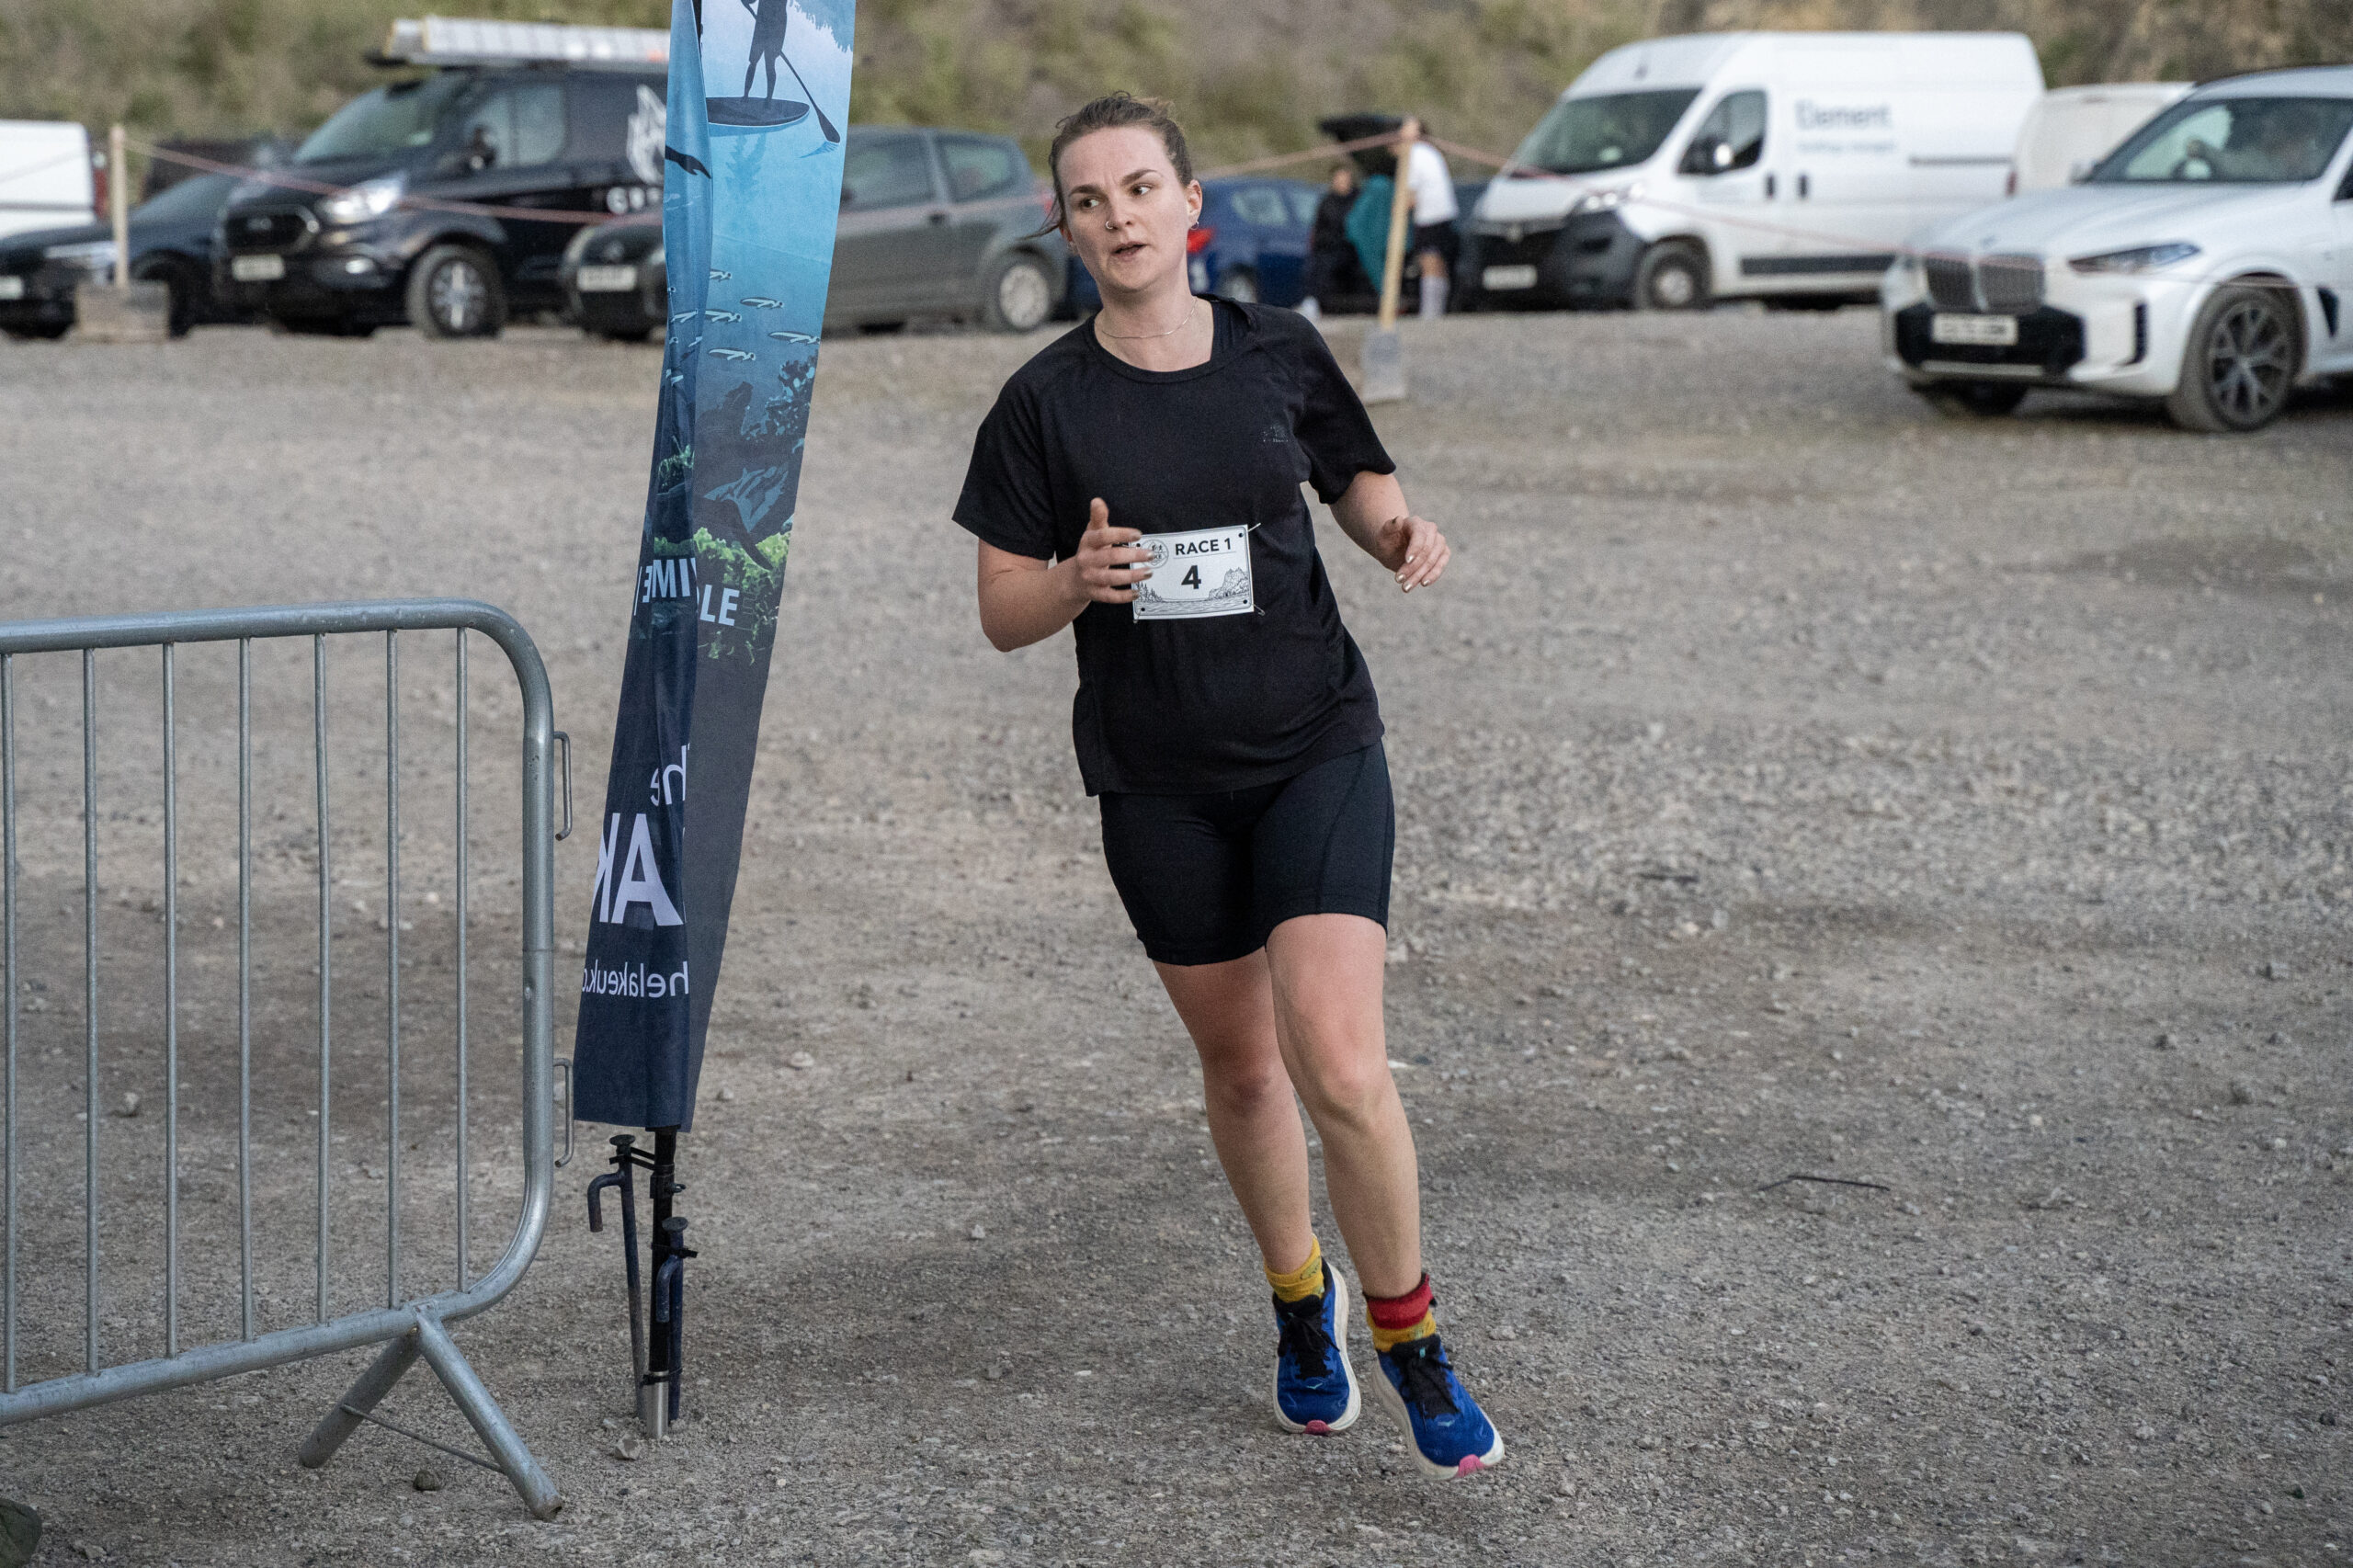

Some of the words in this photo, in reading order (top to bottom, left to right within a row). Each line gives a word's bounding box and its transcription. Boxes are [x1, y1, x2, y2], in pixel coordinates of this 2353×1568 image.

[1175, 539, 1220, 556] RACE
[1224, 538, 1231, 551] 1
[1181, 564, 1201, 589] 4
[696, 584, 740, 627] LE
